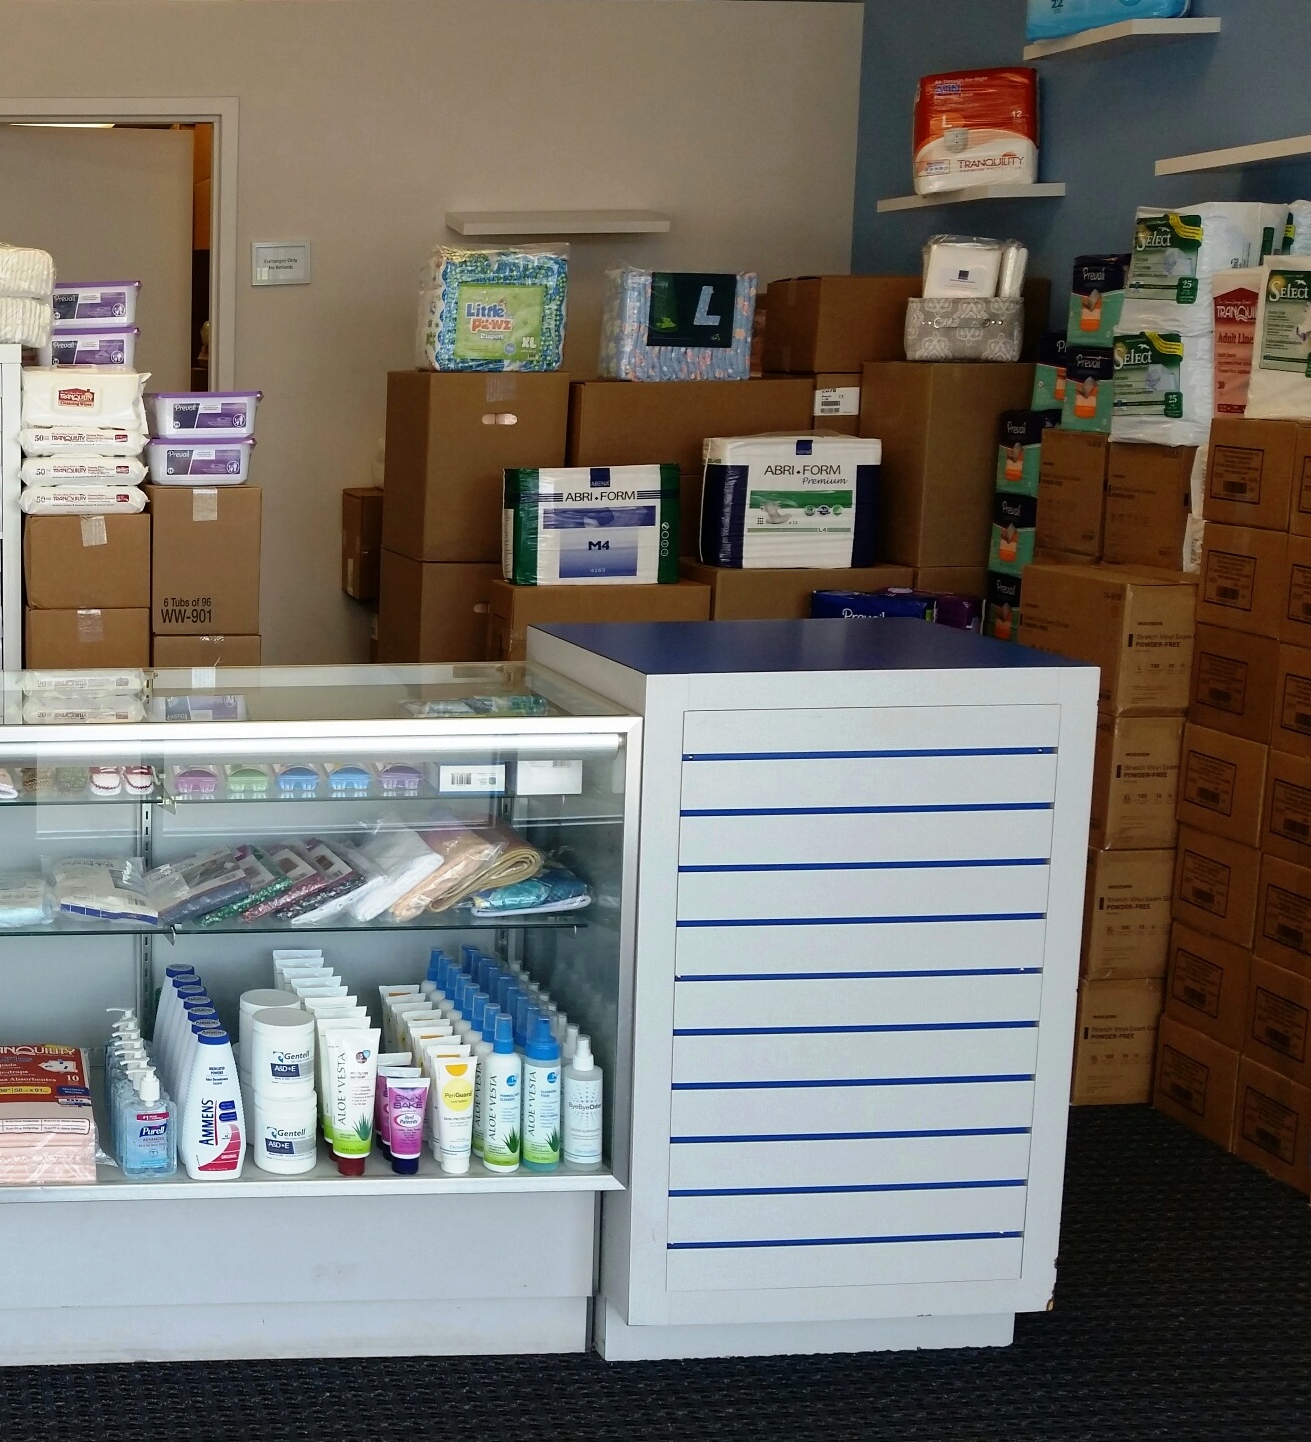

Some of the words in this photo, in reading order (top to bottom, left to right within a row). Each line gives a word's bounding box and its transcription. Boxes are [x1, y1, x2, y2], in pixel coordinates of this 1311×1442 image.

[1011, 110, 1023, 118] 12
[941, 114, 952, 128] L
[957, 156, 1024, 170] TRANQUILITY
[1081, 266, 1106, 281] Prevail
[1182, 280, 1193, 289] 25
[53, 293, 78, 303] Prevail
[465, 302, 507, 318] Little
[692, 285, 722, 326] L
[1216, 305, 1256, 322] TRANQUI
[521, 336, 537, 349] XL
[1217, 332, 1237, 344] Adult
[1237, 333, 1254, 345] Line
[52, 341, 76, 349] Prevail
[1075, 354, 1102, 369] Prevail
[59, 393, 95, 402] TRANQUILITY
[1167, 394, 1178, 404] 25
[174, 403, 198, 412] Prevail
[1006, 420, 1027, 436] Prevail
[34, 434, 44, 442] 50
[51, 434, 86, 442] TRANQUILITY
[168, 451, 191, 459] Prevail
[35, 468, 46, 476] 50
[802, 464, 841, 476] FORM
[801, 476, 849, 485] Premium
[35, 496, 46, 504] 50
[599, 490, 636, 501] FORM
[1001, 500, 1022, 517] Prevail
[587, 540, 610, 551] M4
[163, 597, 169, 607] 6
[170, 597, 190, 607] Tubs
[191, 597, 200, 607] of
[200, 597, 212, 607] 96
[160, 608, 213, 624] WW-901
[284, 1050, 310, 1061] Gentell
[336, 1052, 346, 1089] VESTA
[66, 1074, 80, 1082] 10
[489, 1074, 498, 1108] VESTA
[528, 1071, 537, 1103] VESTA
[444, 1091, 472, 1099] PeriGuard
[337, 1095, 346, 1126] ALOE
[393, 1101, 423, 1109] SAKE
[198, 1099, 215, 1146] AMMENS
[488, 1113, 497, 1141] ALOE
[527, 1109, 536, 1137] ALOE
[142, 1126, 165, 1136] Purell
[277, 1128, 306, 1138] Gentell
